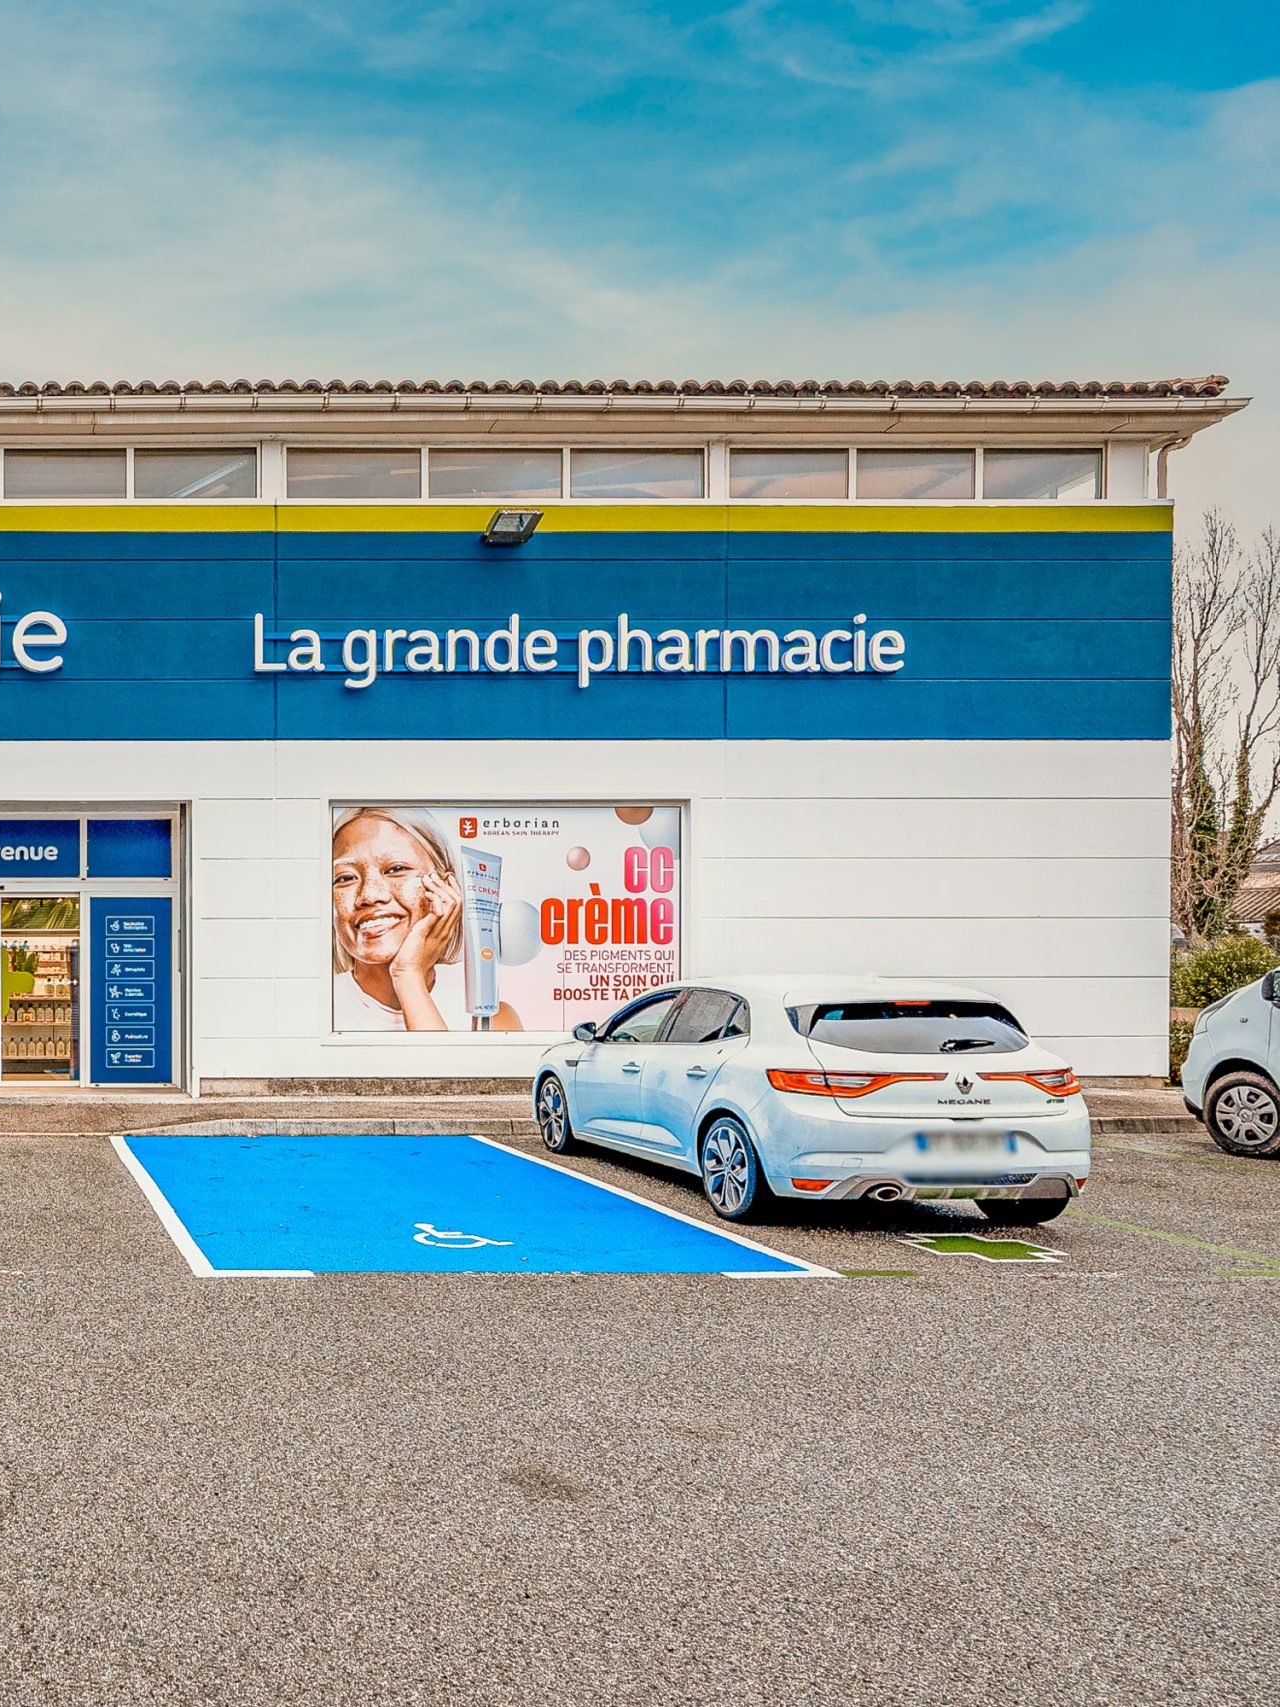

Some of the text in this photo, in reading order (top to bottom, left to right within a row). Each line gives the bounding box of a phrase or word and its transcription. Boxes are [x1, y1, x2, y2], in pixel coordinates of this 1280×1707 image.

[253, 613, 906, 689] La grande pharmacie
[483, 817, 560, 828] erborian
[540, 883, 674, 945] crème
[564, 950, 675, 961] DES PIGMENTS QUI
[556, 962, 573, 974] SE
[589, 974, 610, 987] UN
[613, 974, 647, 987] SOIN
[553, 988, 609, 1001] BOOSTE
[611, 988, 630, 1001] TA
